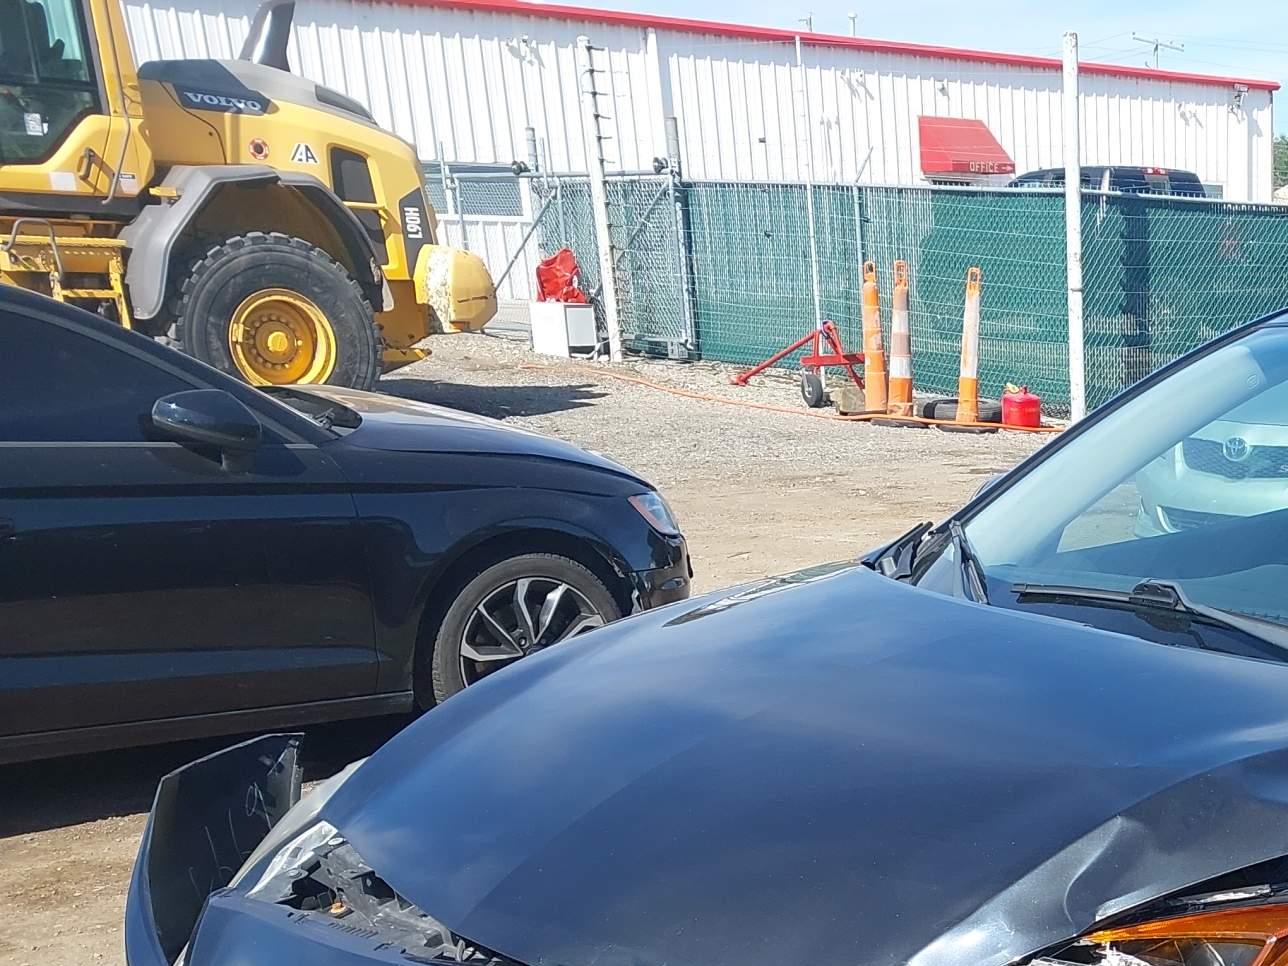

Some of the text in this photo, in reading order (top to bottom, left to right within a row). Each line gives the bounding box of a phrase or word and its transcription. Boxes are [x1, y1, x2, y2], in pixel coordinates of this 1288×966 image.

[183, 91, 262, 111] VOLVO
[969, 161, 999, 172] OFFICE
[403, 207, 424, 239] L90H
